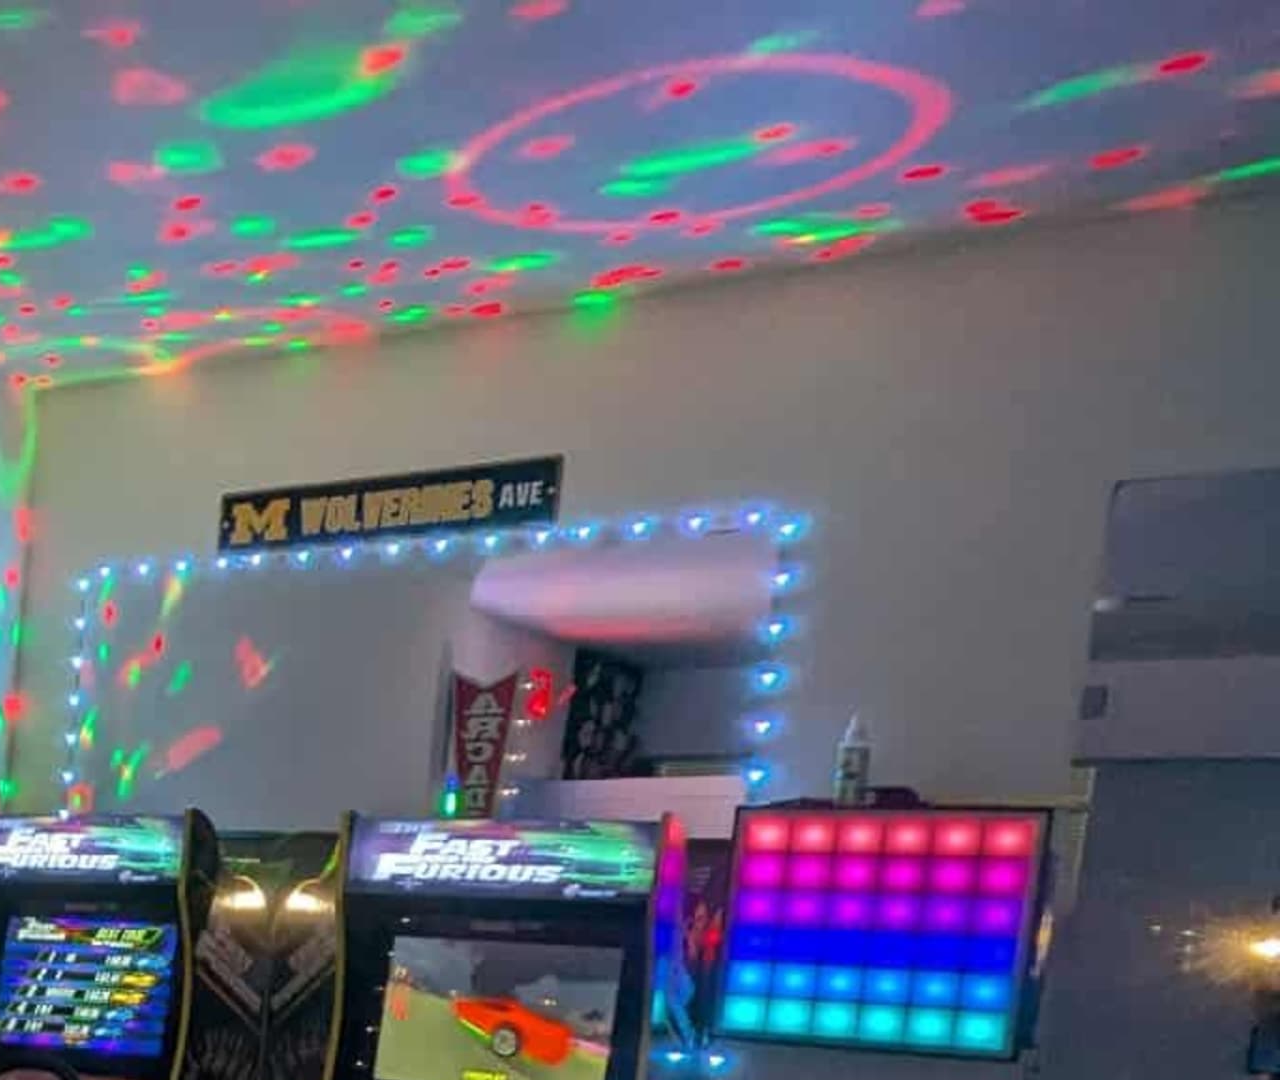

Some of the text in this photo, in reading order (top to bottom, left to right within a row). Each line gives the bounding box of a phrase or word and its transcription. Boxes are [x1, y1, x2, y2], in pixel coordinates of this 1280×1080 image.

[301, 479, 492, 536] WOLVERINES
[499, 480, 544, 509] AVE
[6, 827, 86, 850] FAST
[409, 832, 520, 857] FAST
[372, 852, 564, 883] FURIOUS
